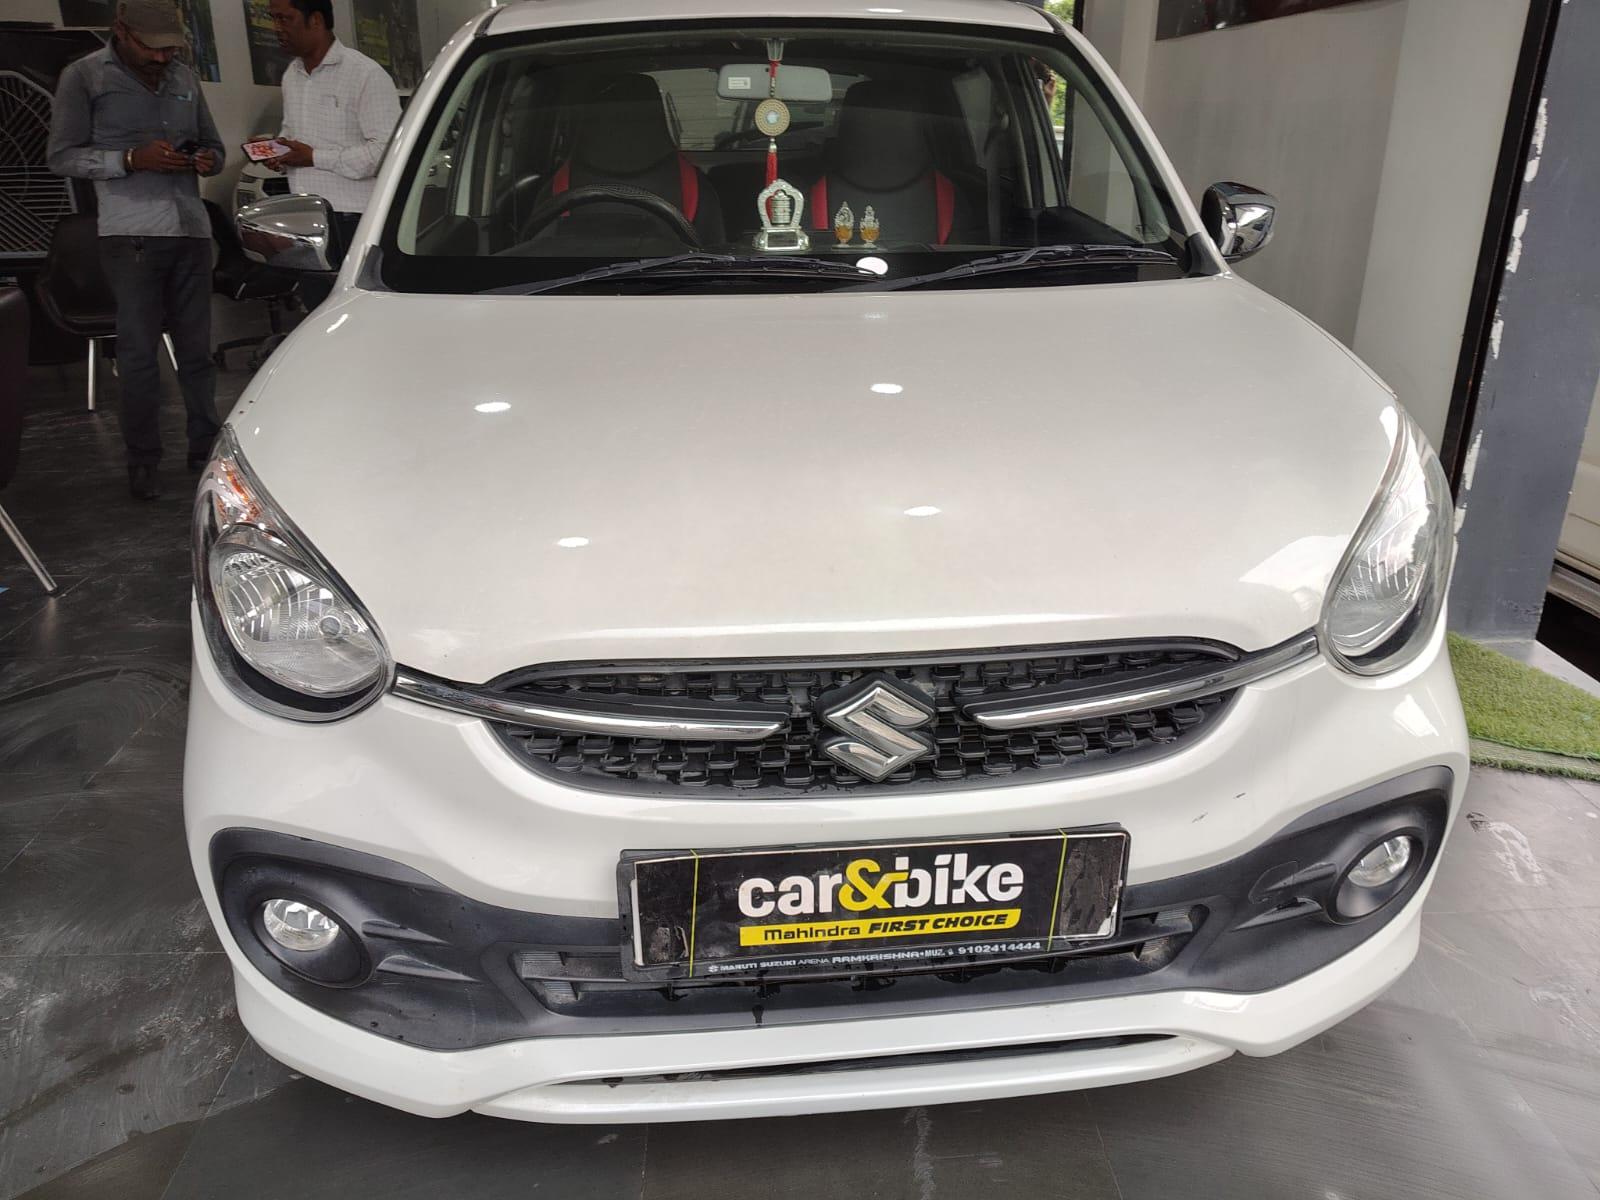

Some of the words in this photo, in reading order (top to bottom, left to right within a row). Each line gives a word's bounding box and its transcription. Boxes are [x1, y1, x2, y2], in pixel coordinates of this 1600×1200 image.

[738, 853, 1024, 917] car&bike
[764, 924, 861, 941] Mahindra
[869, 919, 930, 934] FIRST
[931, 913, 1009, 930] CHOICE
[720, 963, 758, 971] MARUTI
[760, 960, 796, 968] SUZUKI
[797, 958, 830, 966] ARENA
[958, 942, 1041, 954] 9102414444
